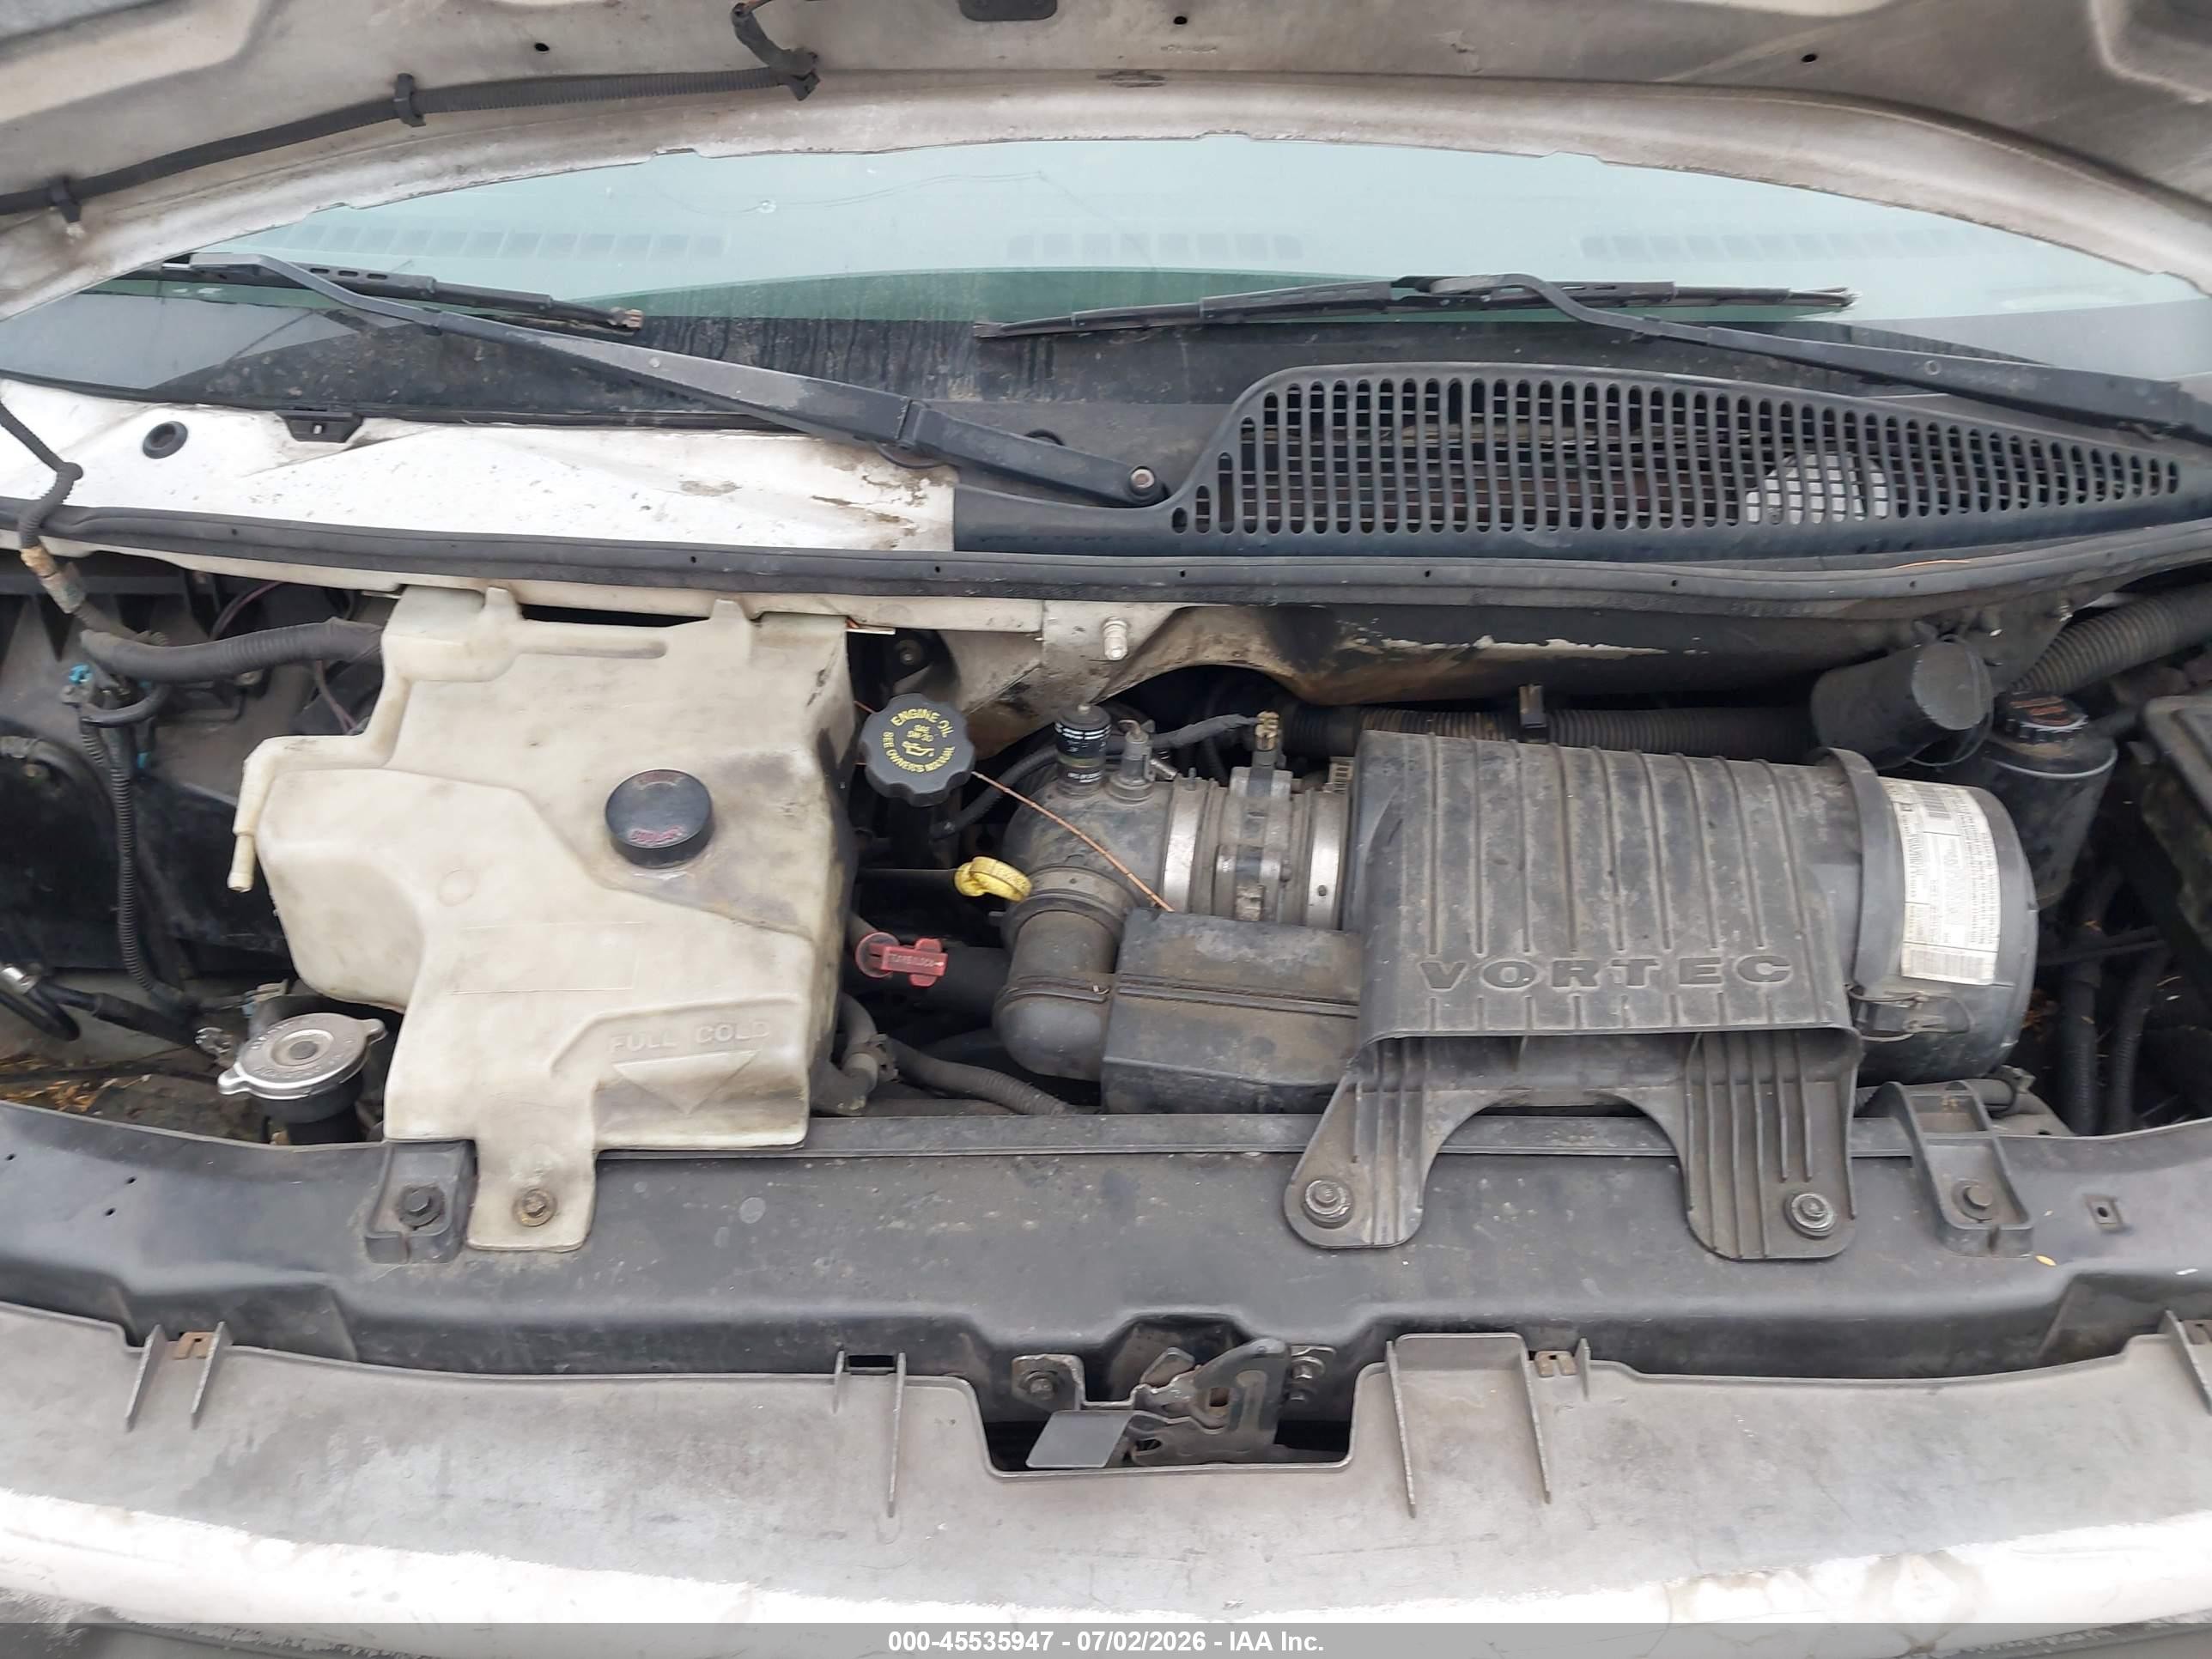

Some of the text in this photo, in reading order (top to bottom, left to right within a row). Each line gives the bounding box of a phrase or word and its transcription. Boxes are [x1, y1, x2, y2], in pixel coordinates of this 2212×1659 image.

[890, 708, 954, 738] ENGINE OIL
[882, 732, 895, 749] SEE
[924, 746, 956, 772] MANUAL
[1419, 955, 1793, 990] VORTEC
[611, 1019, 770, 1053] FULL COLD
